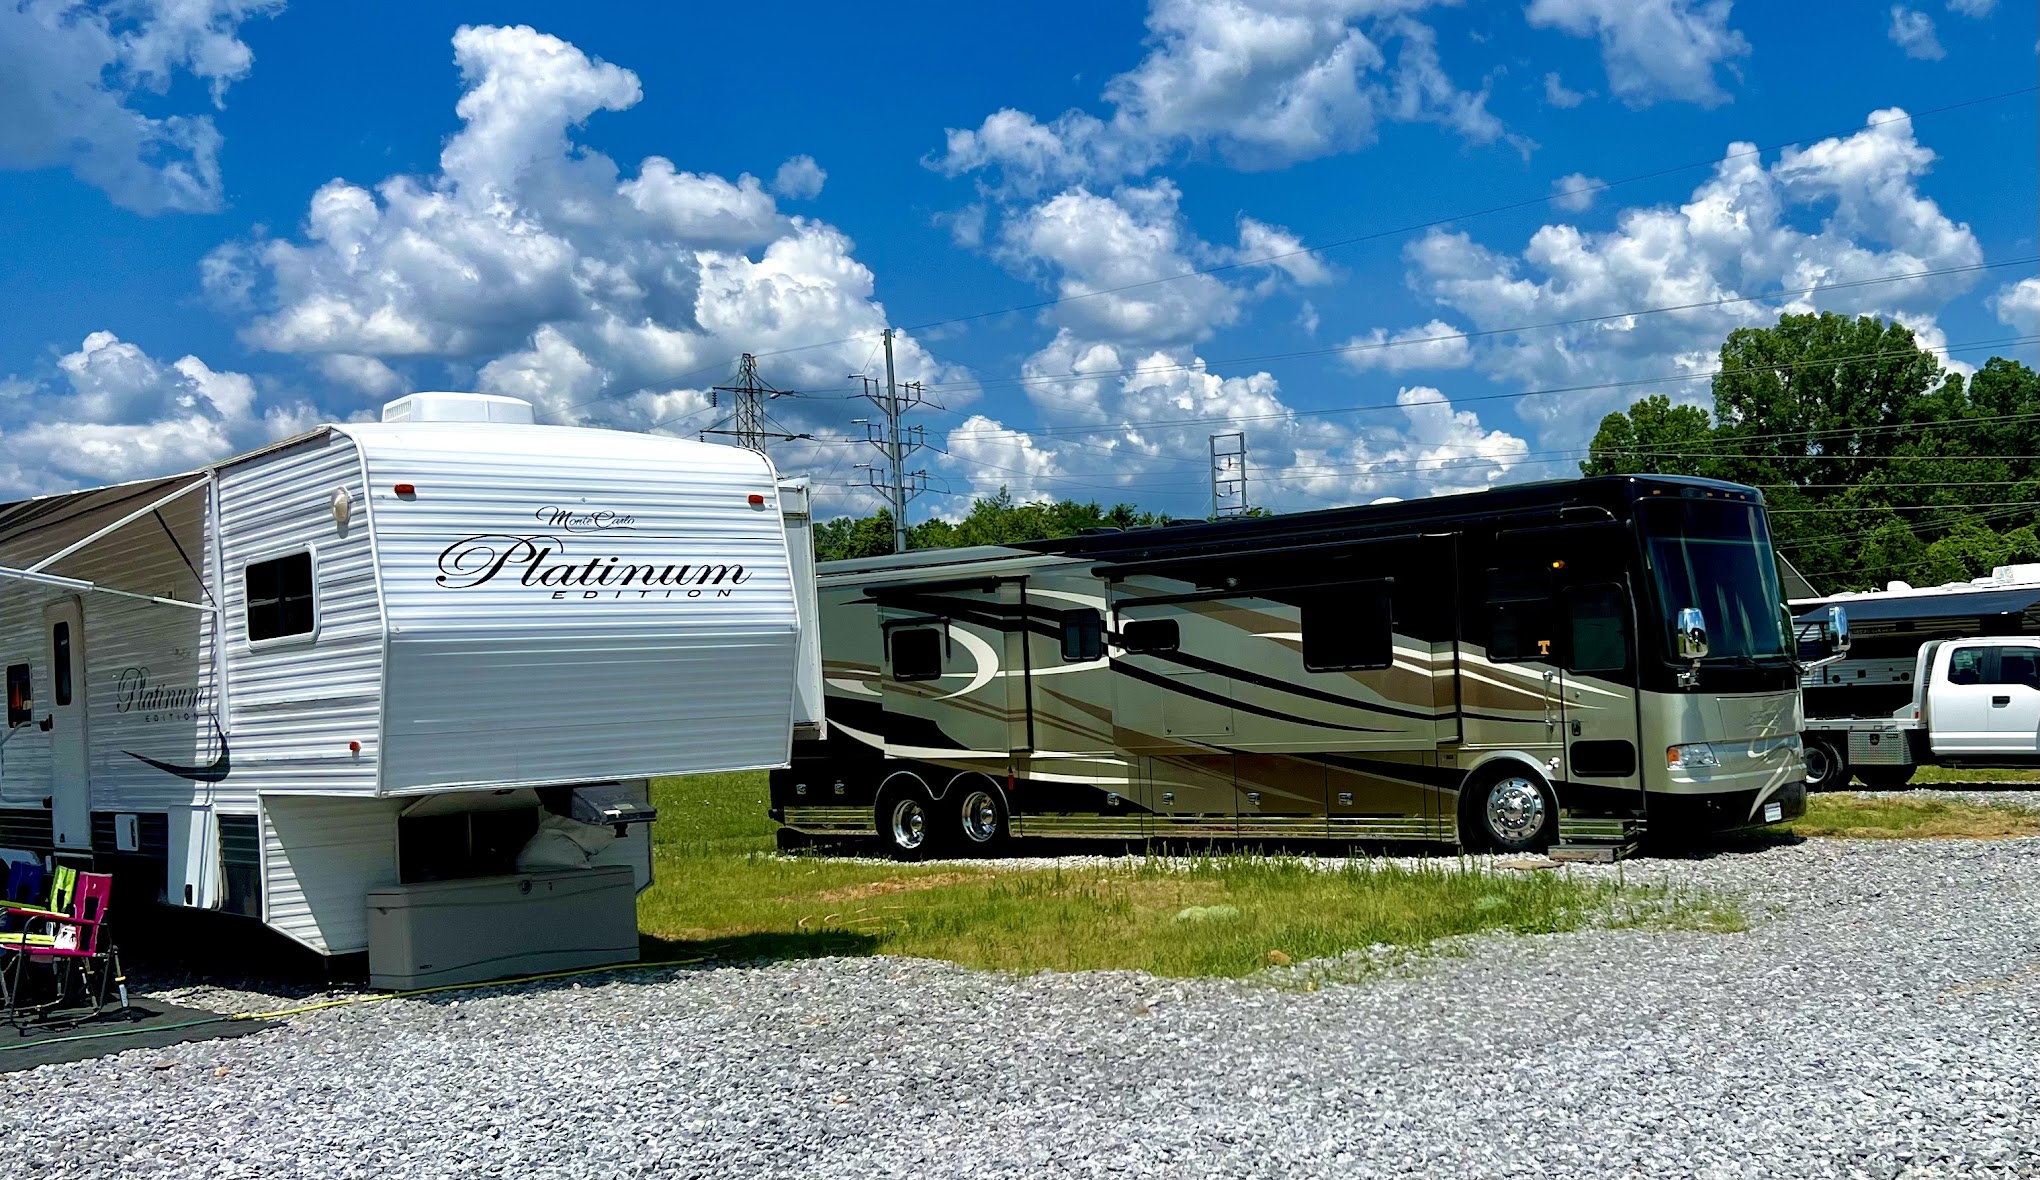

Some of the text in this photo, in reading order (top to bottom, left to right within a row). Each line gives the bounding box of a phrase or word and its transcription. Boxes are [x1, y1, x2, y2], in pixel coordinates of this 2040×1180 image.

[535, 506, 635, 533] Monte Carlo
[435, 535, 753, 588] Platinum
[551, 590, 732, 600] EDITION
[1538, 640, 1550, 655] T
[117, 667, 205, 713] Platinum
[145, 713, 199, 723] EDITION
